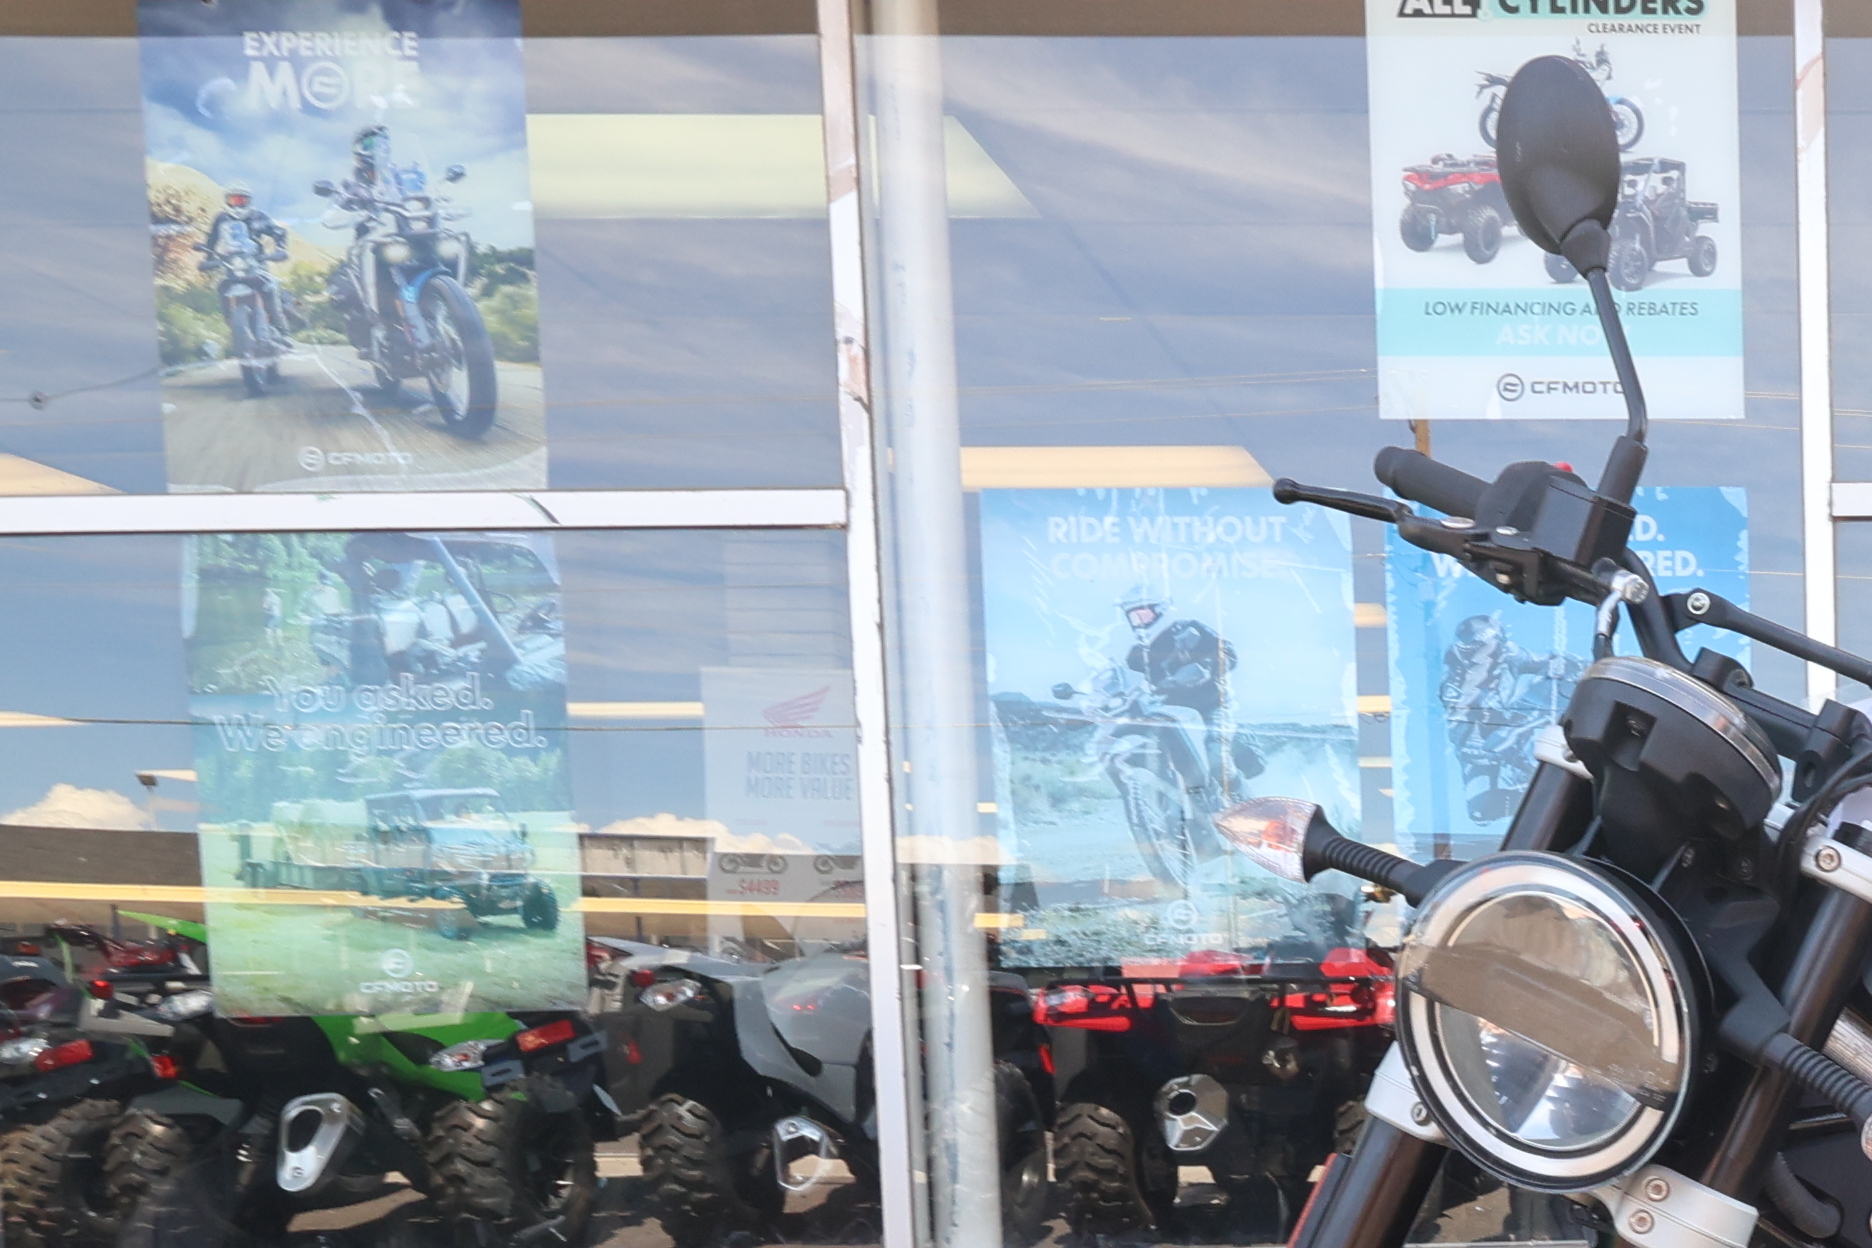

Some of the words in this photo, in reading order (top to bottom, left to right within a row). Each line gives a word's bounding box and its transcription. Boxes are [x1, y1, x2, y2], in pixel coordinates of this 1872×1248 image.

[1587, 22, 1659, 34] CLEARANCE
[1662, 23, 1702, 34] EVENT
[243, 31, 419, 56] EXPERIENCE
[1424, 301, 1467, 316] LOW
[1470, 301, 1576, 316] FINANCING
[1625, 302, 1699, 316] REBATES
[1496, 324, 1553, 346] ASK
[1557, 324, 1630, 346] NO
[1049, 515, 1120, 543] RIDE
[1128, 515, 1286, 543] WITHOUT
[262, 675, 347, 713] You
[353, 671, 495, 713] asked.
[213, 712, 287, 751] We
[294, 709, 548, 762] engineered.
[764, 728, 834, 739] HONDA
[746, 750, 797, 774] MORE
[801, 752, 850, 775] BIKES
[745, 775, 794, 799] MORE
[800, 777, 853, 801] VALUE
[359, 980, 439, 994] CFMOTO
